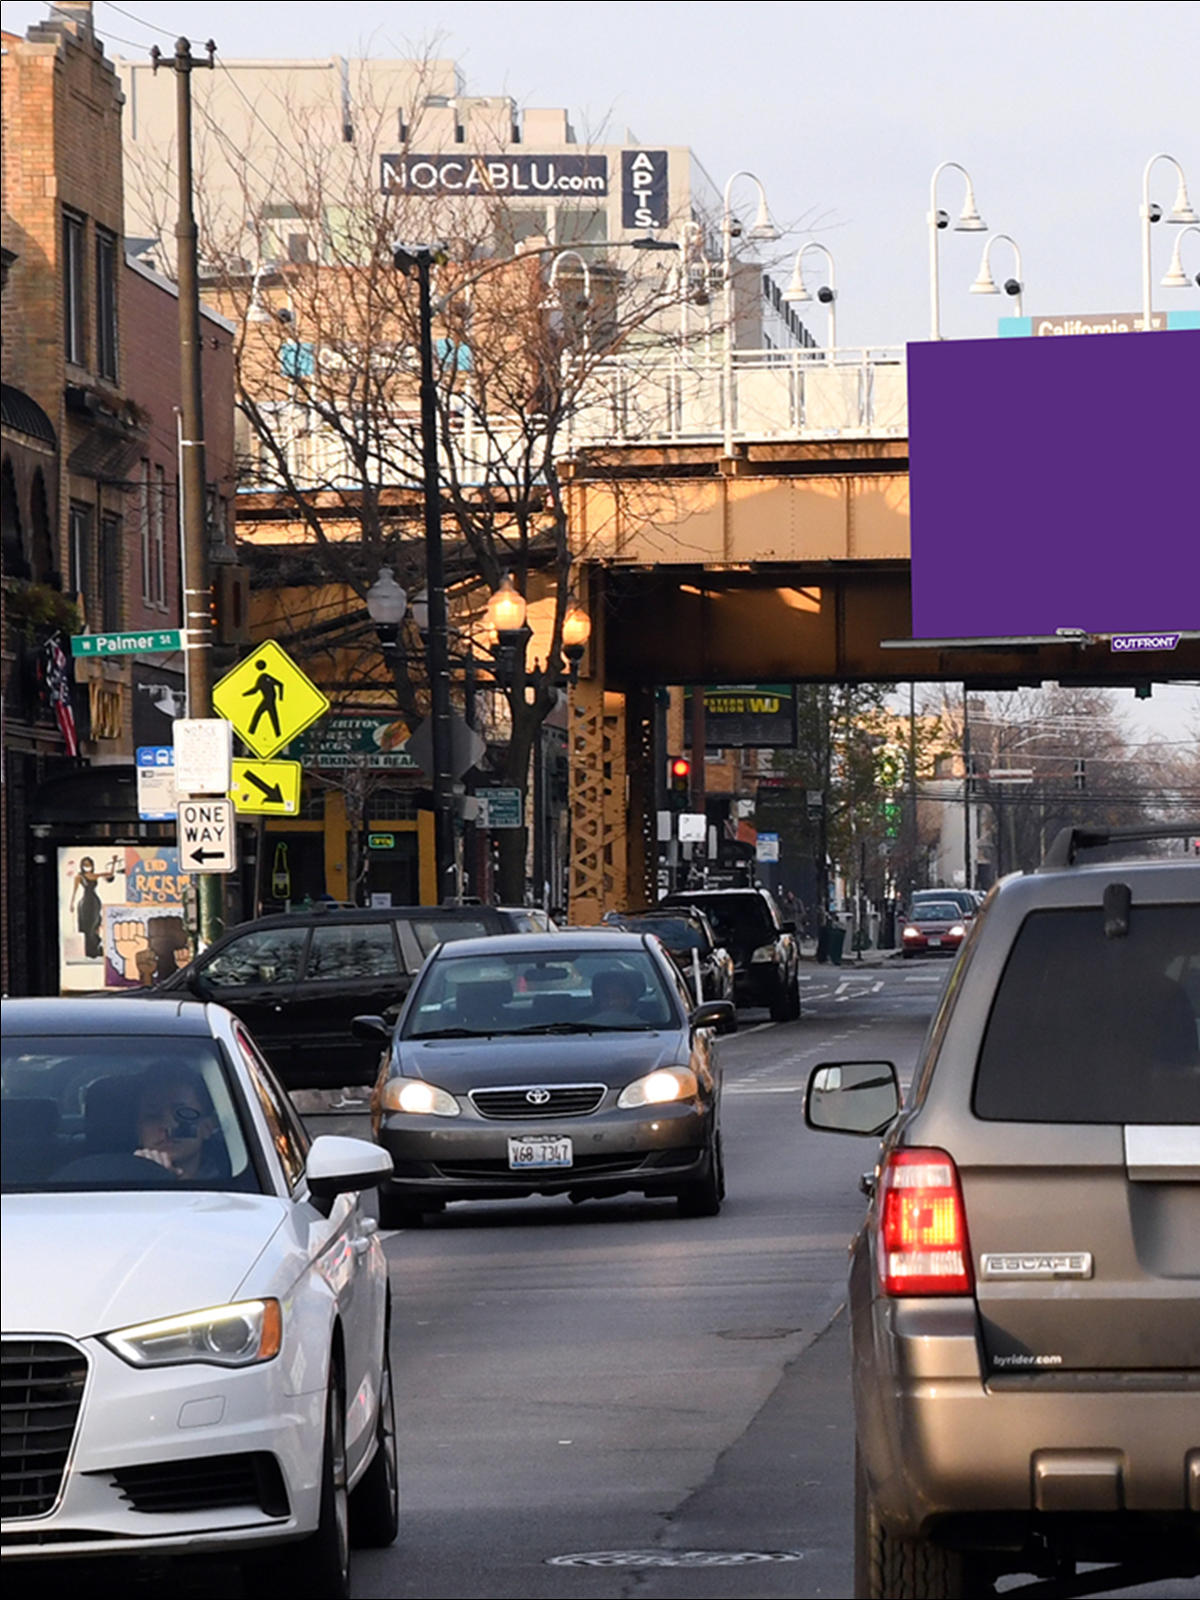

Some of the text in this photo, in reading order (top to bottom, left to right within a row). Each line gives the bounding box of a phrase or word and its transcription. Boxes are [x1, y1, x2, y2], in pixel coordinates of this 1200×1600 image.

[383, 160, 604, 191] NOCABLU.com
[1039, 318, 1128, 336] California
[96, 636, 154, 652] Palmer
[1114, 636, 1175, 649] OUTFRONT
[709, 705, 745, 713] UNION
[184, 806, 225, 824] ONE
[184, 826, 225, 843] WAY
[144, 859, 168, 872] END
[993, 1353, 1062, 1367] byrider.com
